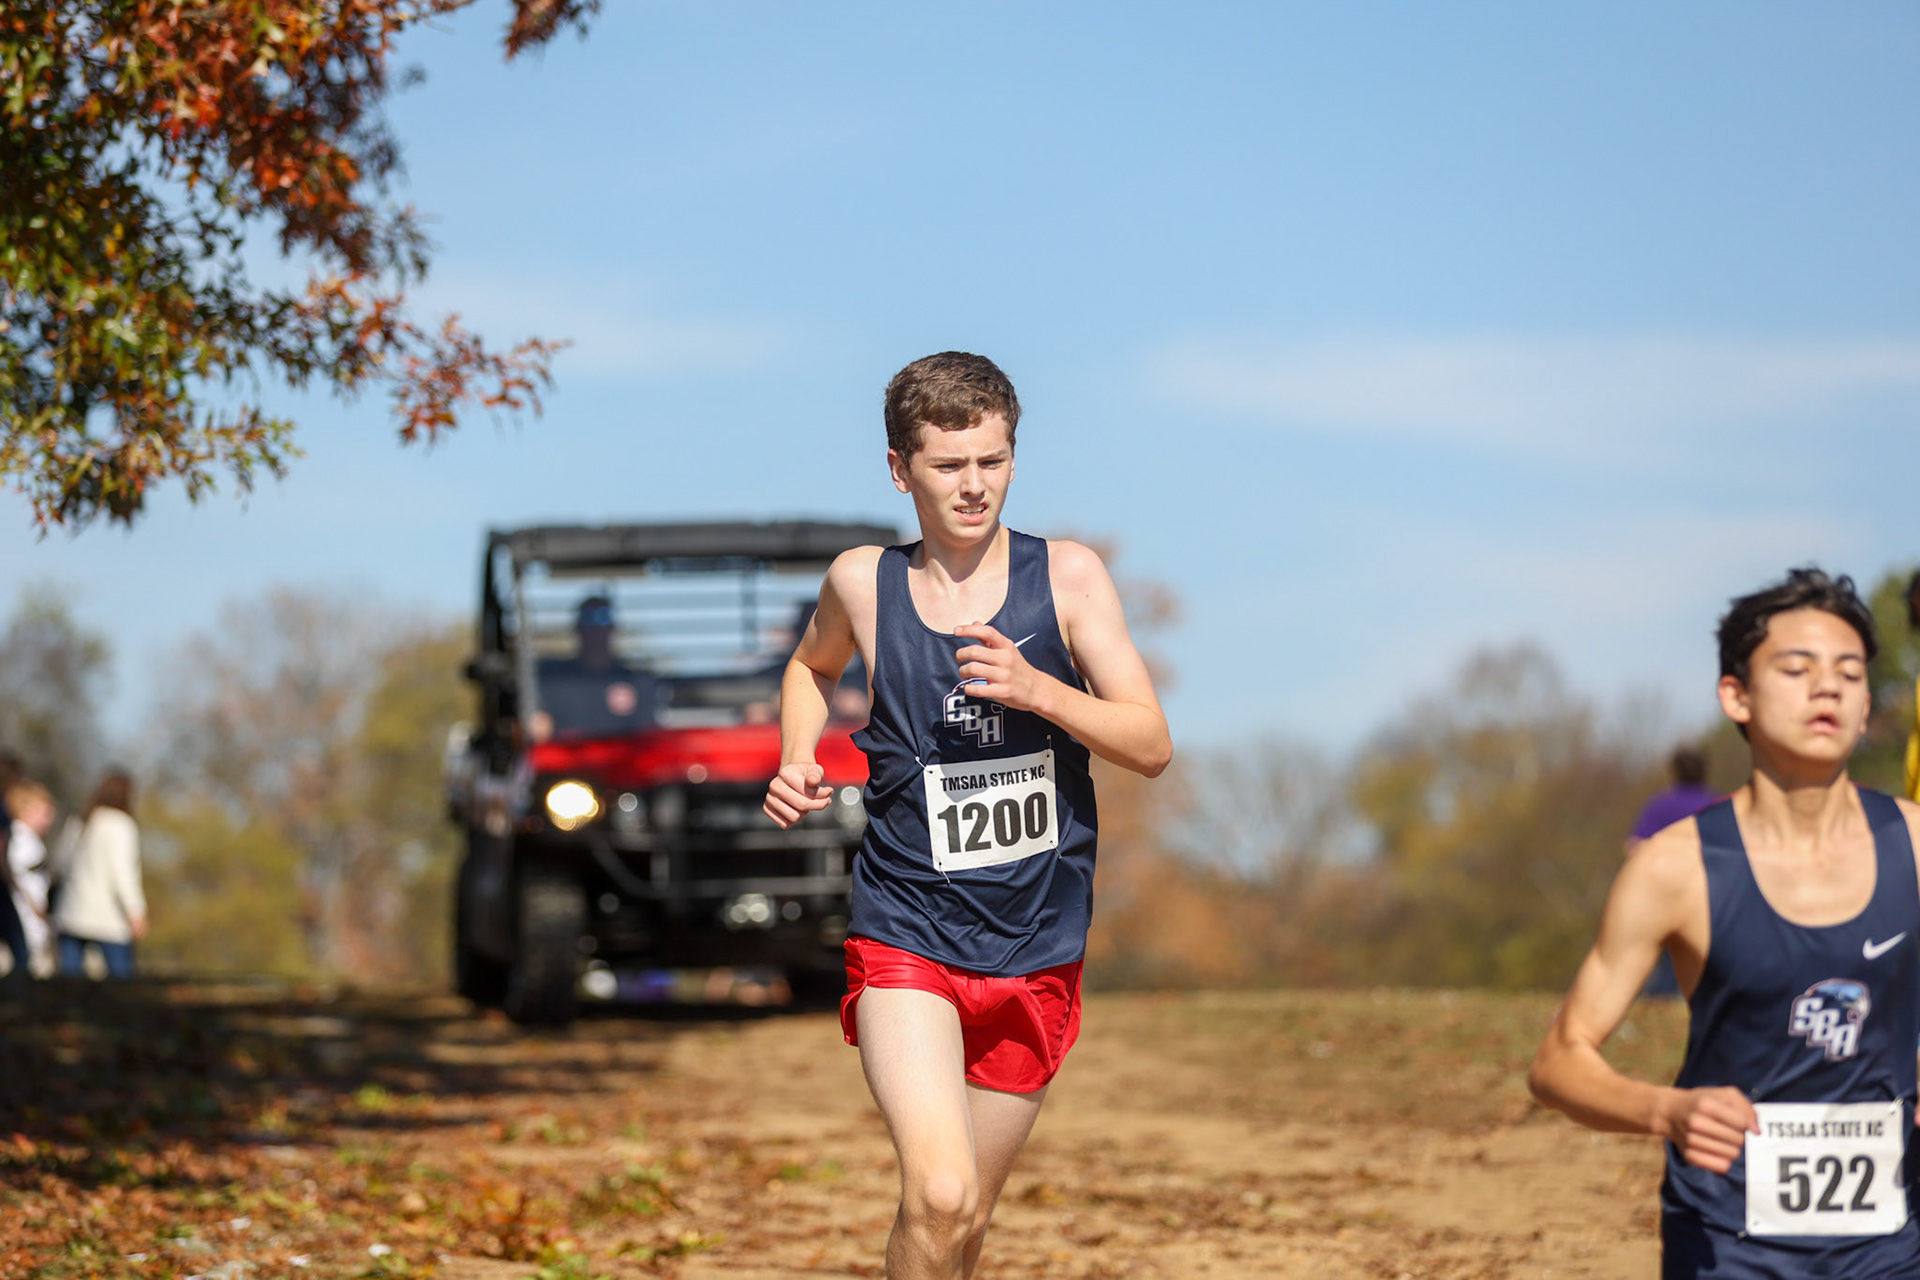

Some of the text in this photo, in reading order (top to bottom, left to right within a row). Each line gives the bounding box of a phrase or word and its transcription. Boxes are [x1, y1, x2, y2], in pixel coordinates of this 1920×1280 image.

[947, 695, 1001, 744] SBA
[940, 764, 1046, 792] TMSAA STATE XC
[937, 791, 1048, 854] 1200
[1793, 996, 1857, 1057] SBA
[1766, 1120, 1885, 1138] TSSAA STATE XC
[1778, 1154, 1876, 1213] 522
